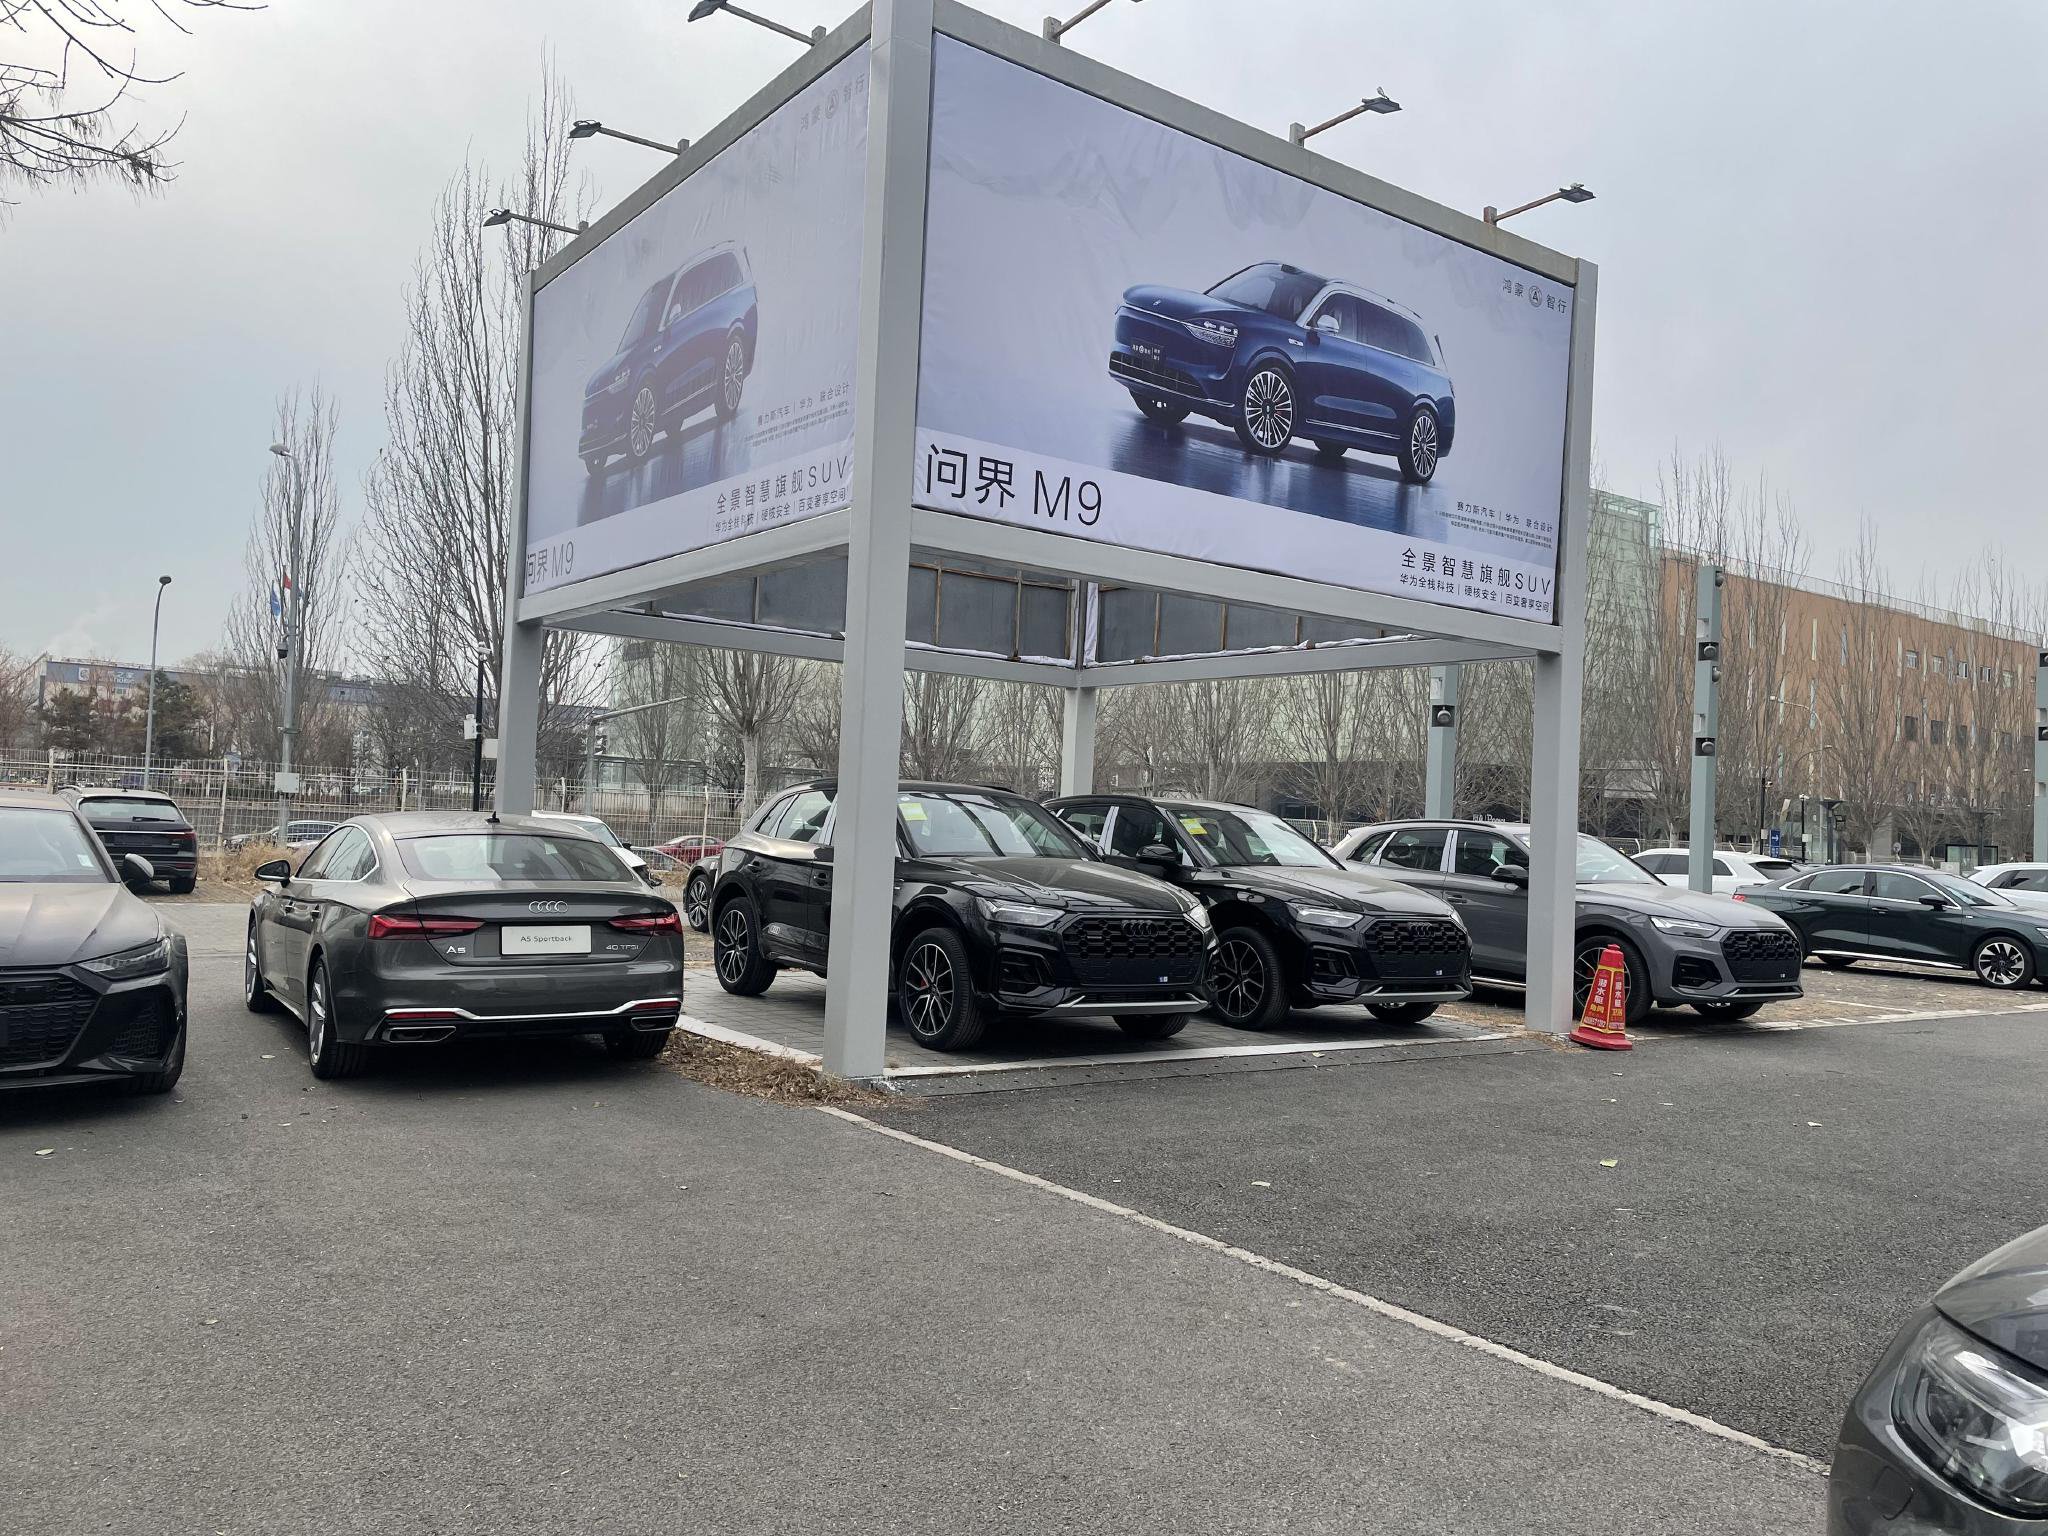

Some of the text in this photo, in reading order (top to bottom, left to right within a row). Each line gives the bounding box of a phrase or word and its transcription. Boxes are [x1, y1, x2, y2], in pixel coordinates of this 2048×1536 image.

[1546, 294, 1567, 314] 智行
[716, 455, 848, 515] 全景智慧旗舰SUV
[926, 444, 1102, 526] 问界 M9
[1504, 513, 1520, 526] 华为
[525, 541, 574, 587] 问界 M9
[1401, 547, 1551, 595] 全景智慧旗舰SUV
[1463, 585, 1498, 602] 硬核安全
[520, 935, 573, 943] A5 Sportback
[446, 945, 466, 954] A5
